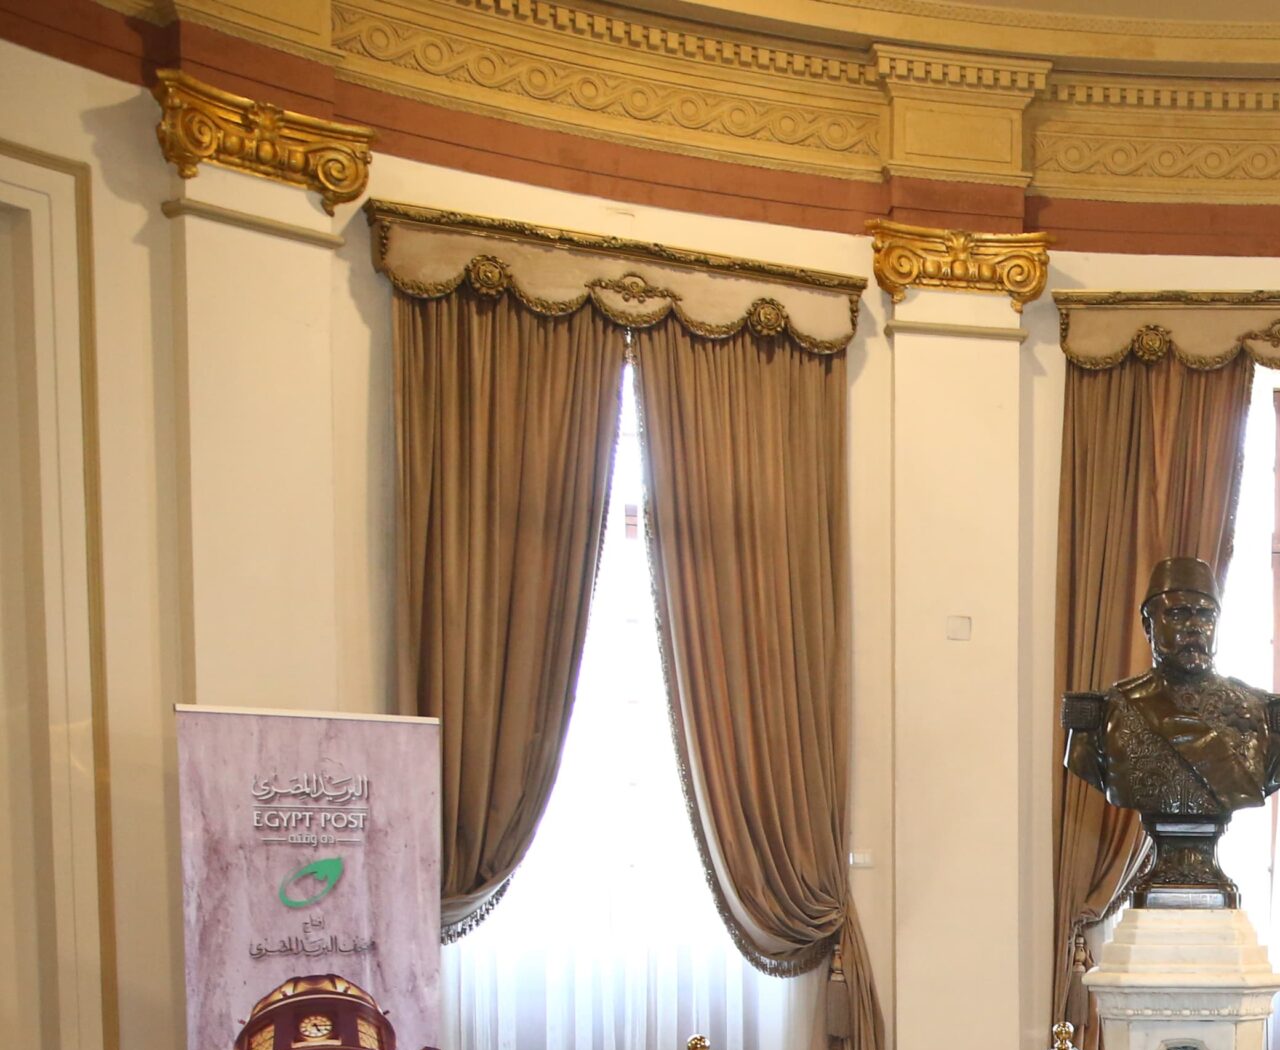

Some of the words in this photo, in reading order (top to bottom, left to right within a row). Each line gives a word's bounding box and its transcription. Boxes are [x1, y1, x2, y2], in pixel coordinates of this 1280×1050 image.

[311, 772, 369, 803] البريد
[253, 811, 314, 829] EGYPT
[320, 812, 367, 829] POST
[297, 935, 338, 958] البريد
